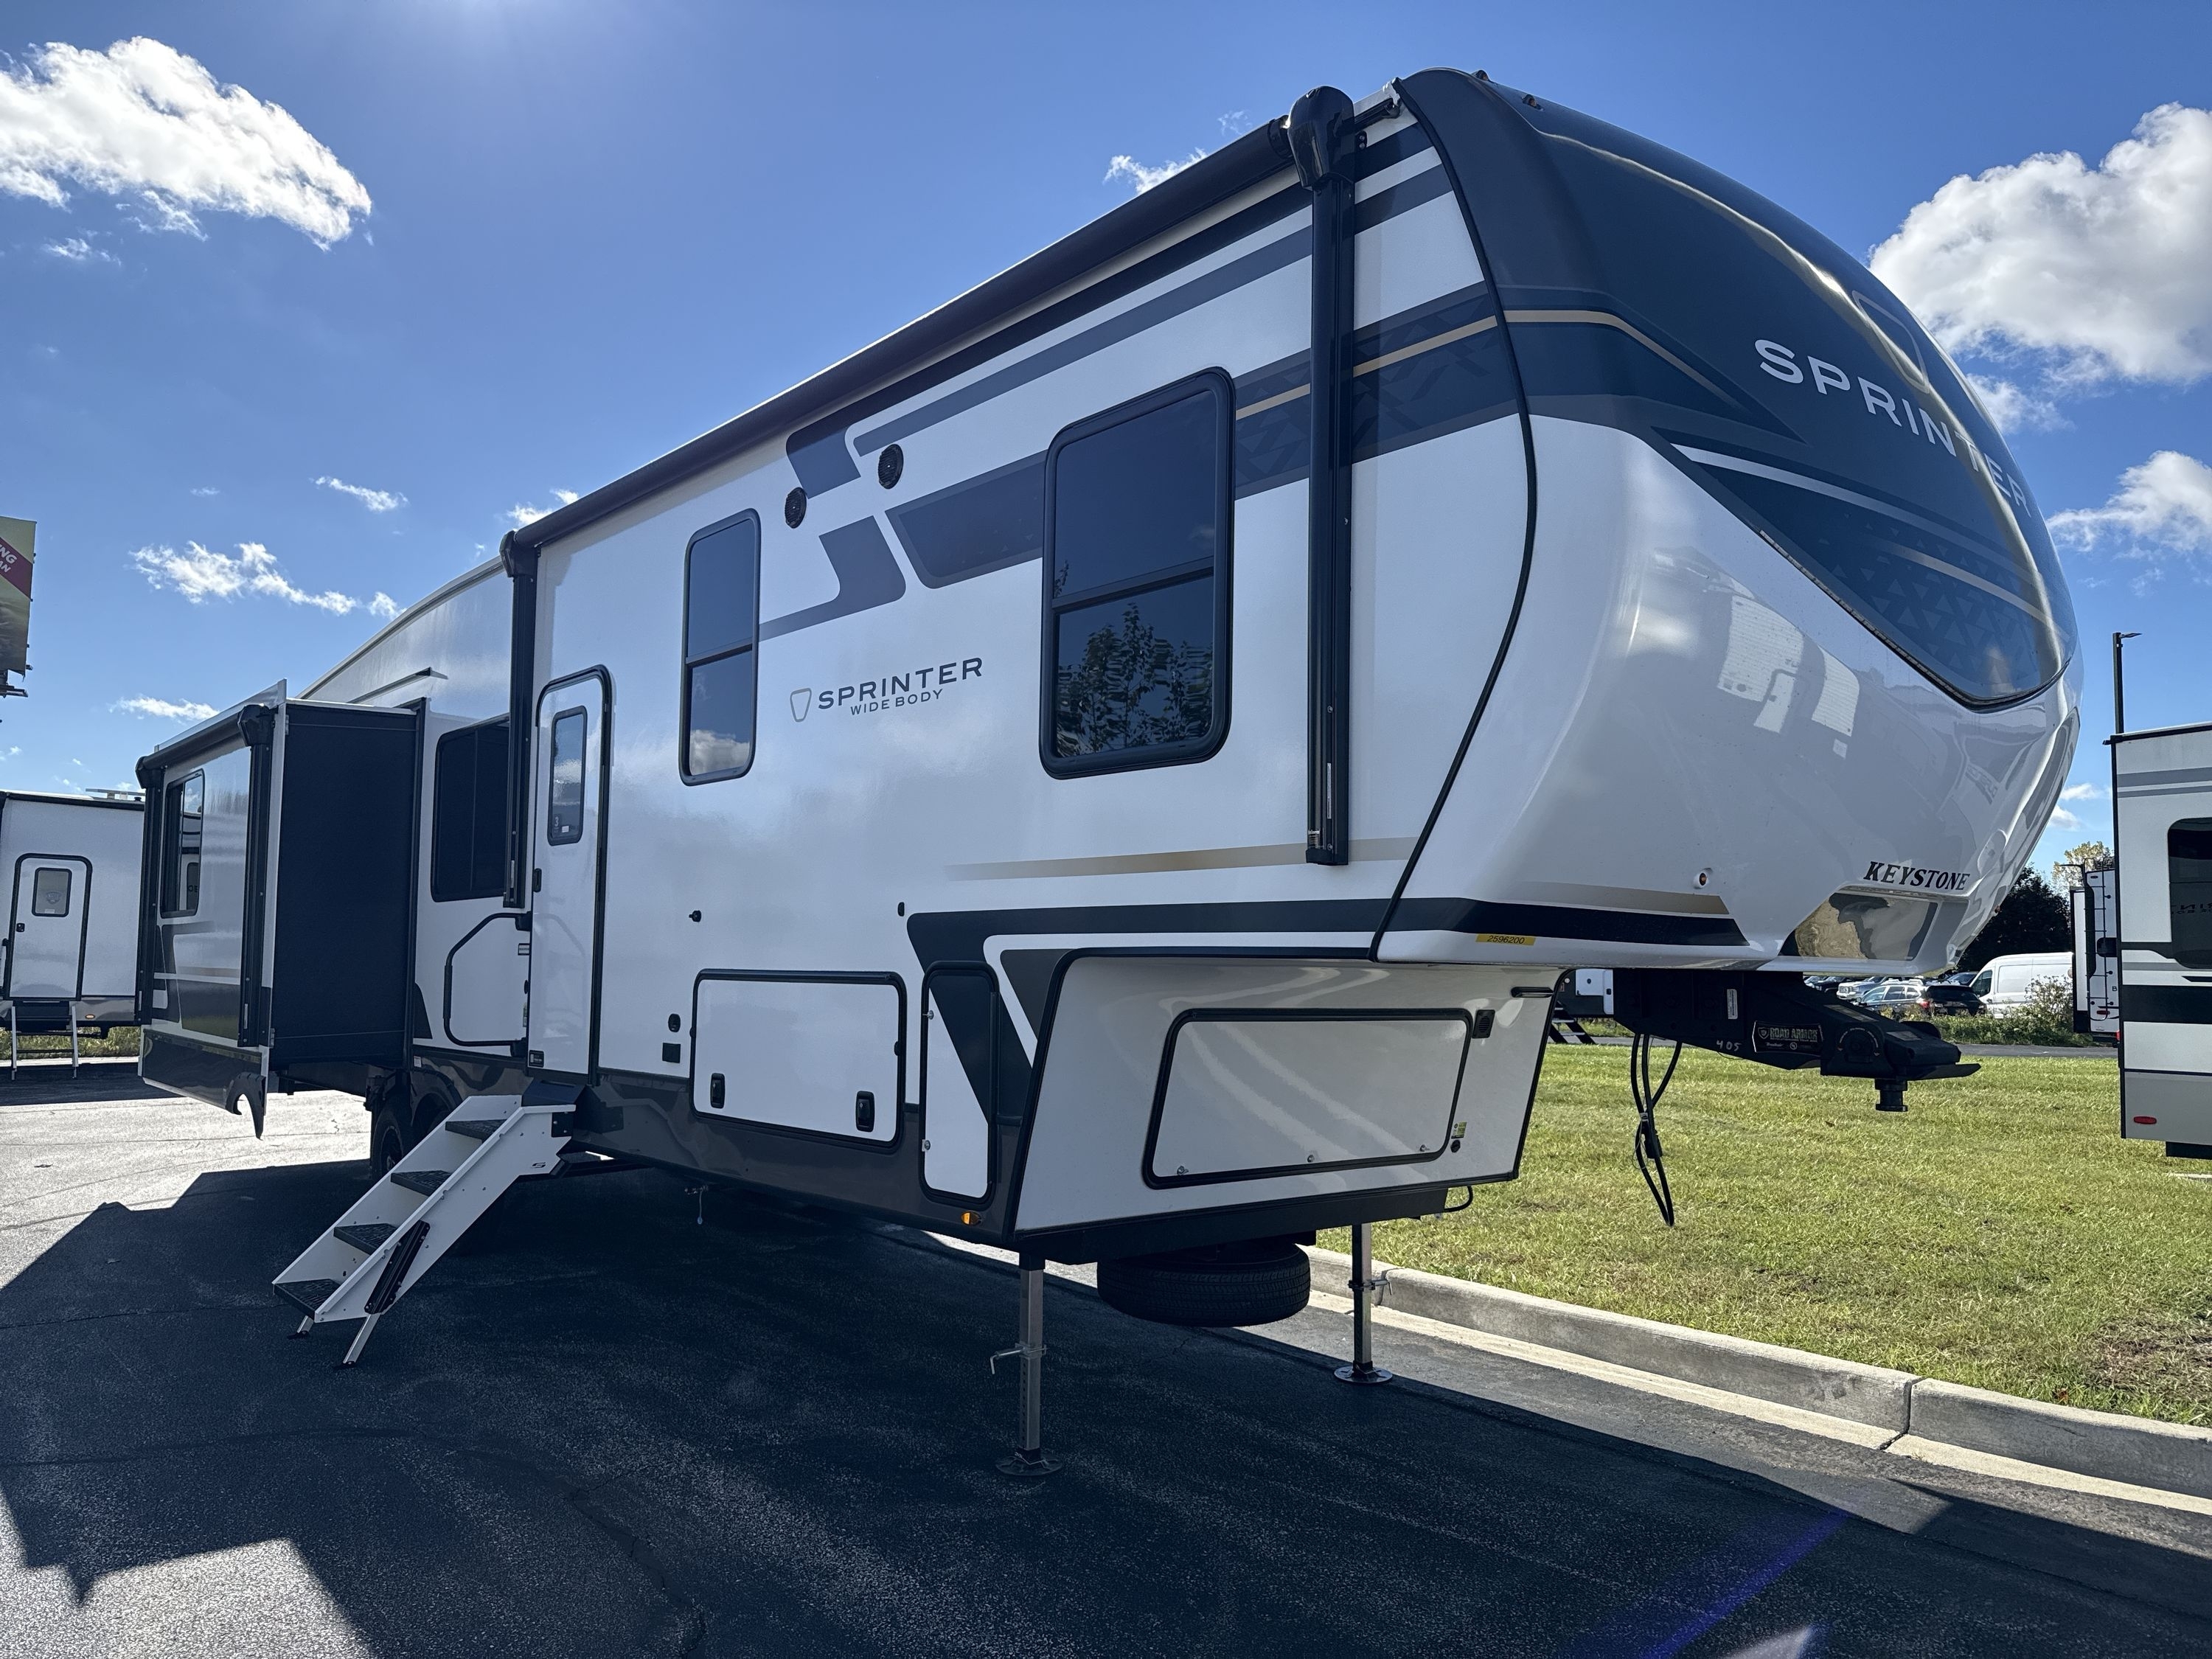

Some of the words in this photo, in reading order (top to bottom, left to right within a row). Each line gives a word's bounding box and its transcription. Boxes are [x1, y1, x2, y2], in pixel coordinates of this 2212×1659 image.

[1754, 339, 2032, 518] SPRINTER
[818, 657, 983, 709] SPRINTER
[850, 699, 890, 715] WIDE
[894, 688, 943, 707] BODY
[1863, 860, 1971, 891] KEYSTONE
[1486, 935, 1525, 945] 2596200
[1716, 1039, 1742, 1051] 405
[1770, 1027, 1790, 1038] ROAD
[1791, 1029, 1818, 1040] ARMOR
